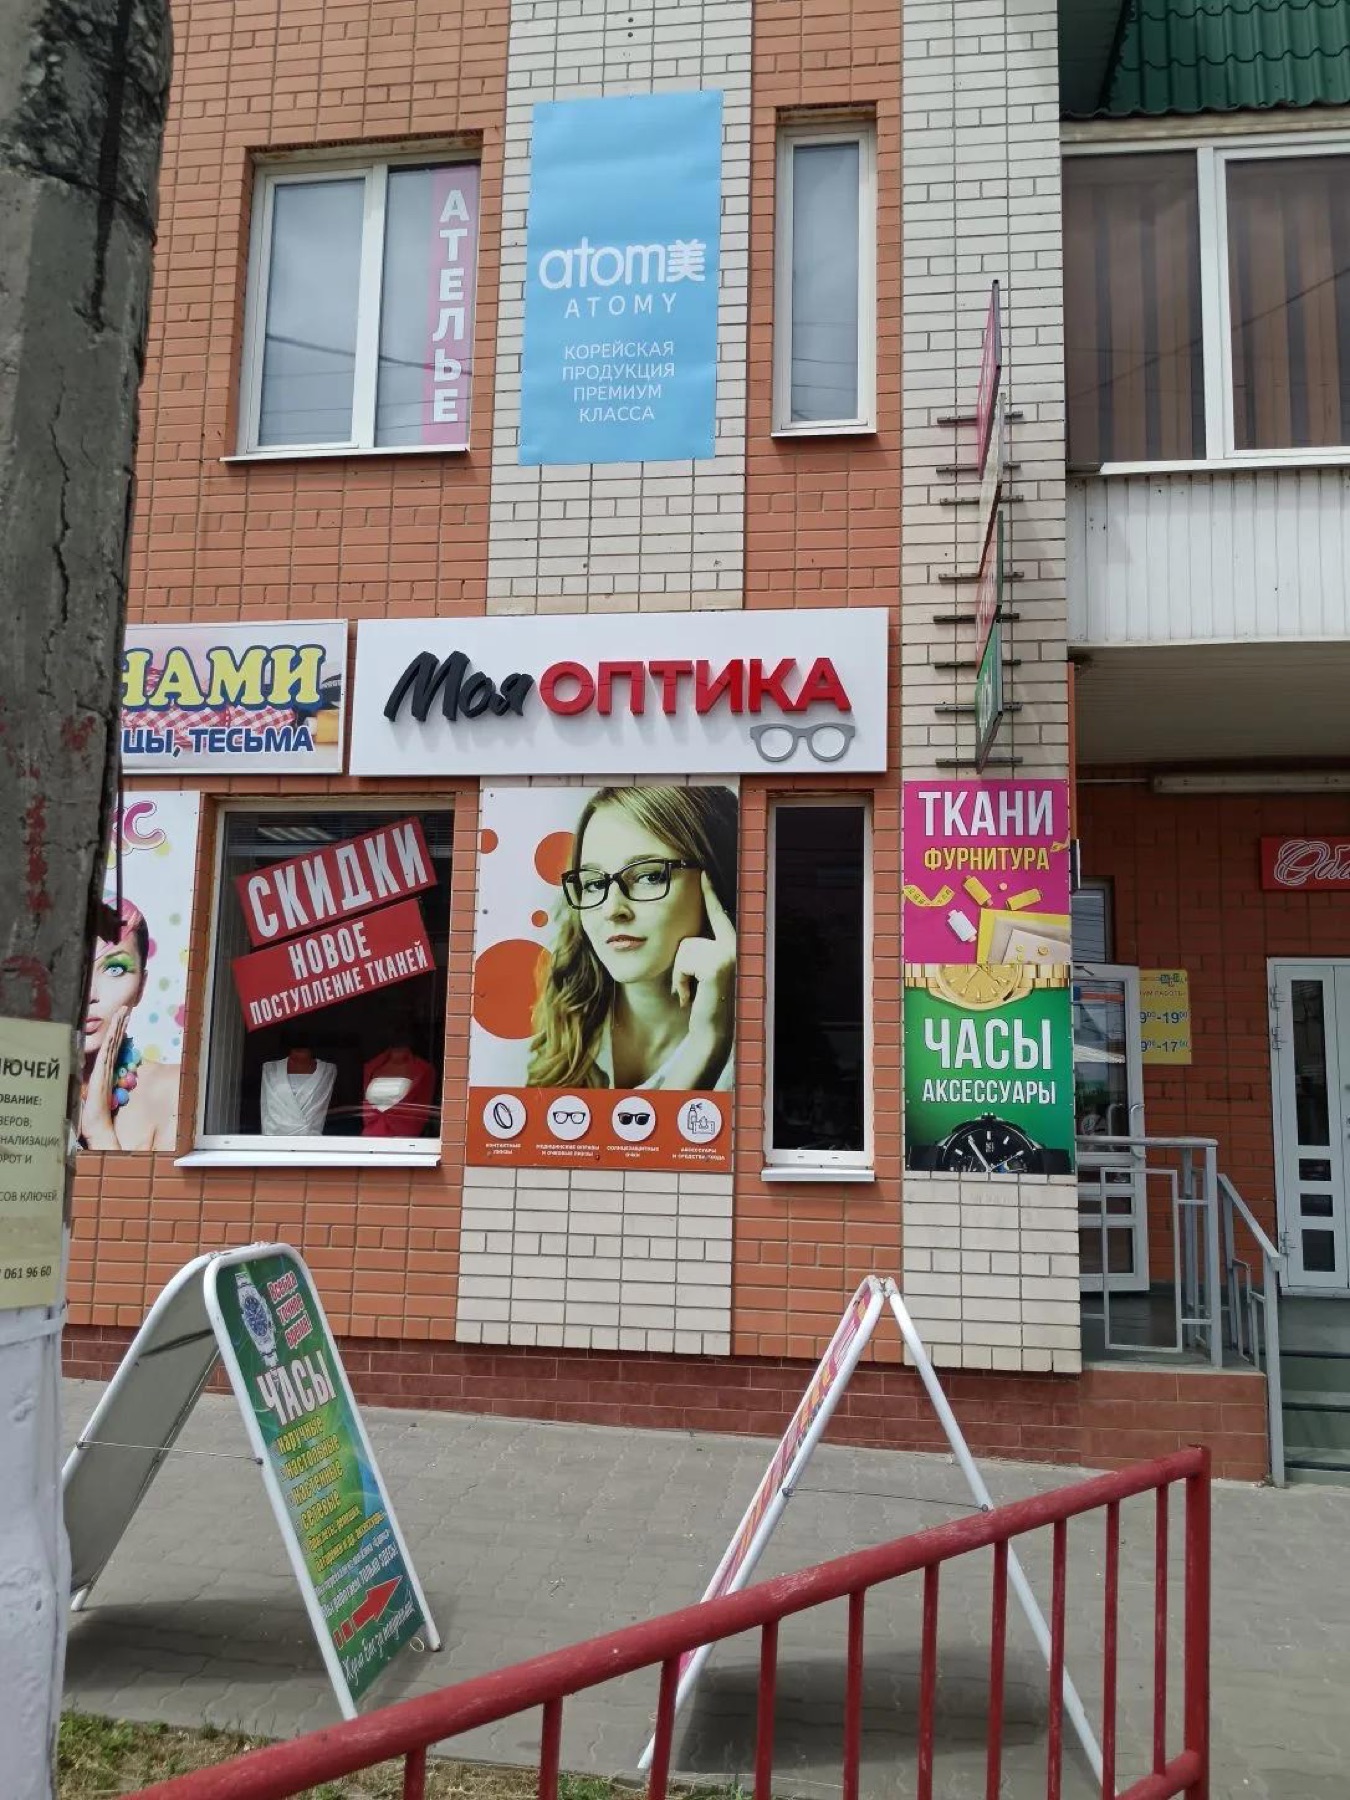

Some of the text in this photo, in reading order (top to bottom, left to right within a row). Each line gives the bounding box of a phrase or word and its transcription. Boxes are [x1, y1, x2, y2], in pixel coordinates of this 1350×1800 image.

[432, 189, 470, 422] АТЕЛЬЕ
[564, 292, 677, 319] ATOMY
[564, 340, 675, 360] КОРЕЙСКАЯ
[562, 362, 675, 382] ПРОДУКЦИЯ
[573, 384, 662, 402] ПРЕМИУМ
[579, 406, 655, 423] КЛАССА
[383, 650, 852, 722] Моя ОПТИКА
[188, 728, 314, 753] ТЕСЬМА
[918, 790, 1053, 836] ТКАНИ
[924, 847, 1049, 871] ФУРНИТУРА
[248, 823, 428, 938] СКИДКИ
[287, 921, 372, 980] НОВОЕ
[249, 939, 428, 1025] ПОСТУПЛЕНИЕ ТКАНЕЙ
[924, 1018, 1053, 1070] ЧАСЫ
[0, 1058, 60, 1080] ЮЧЕЙ
[922, 1078, 1056, 1105] АКСЕССУАРЫ
[25, 1155, 32, 1164] И
[4, 1265, 52, 1279] 061 96 60
[257, 1350, 337, 1425] ЧАСЫ
[276, 1416, 323, 1455] наручные
[285, 1433, 340, 1479] настольные
[291, 1459, 343, 1506] настенные
[301, 1489, 340, 1531] сетевые
